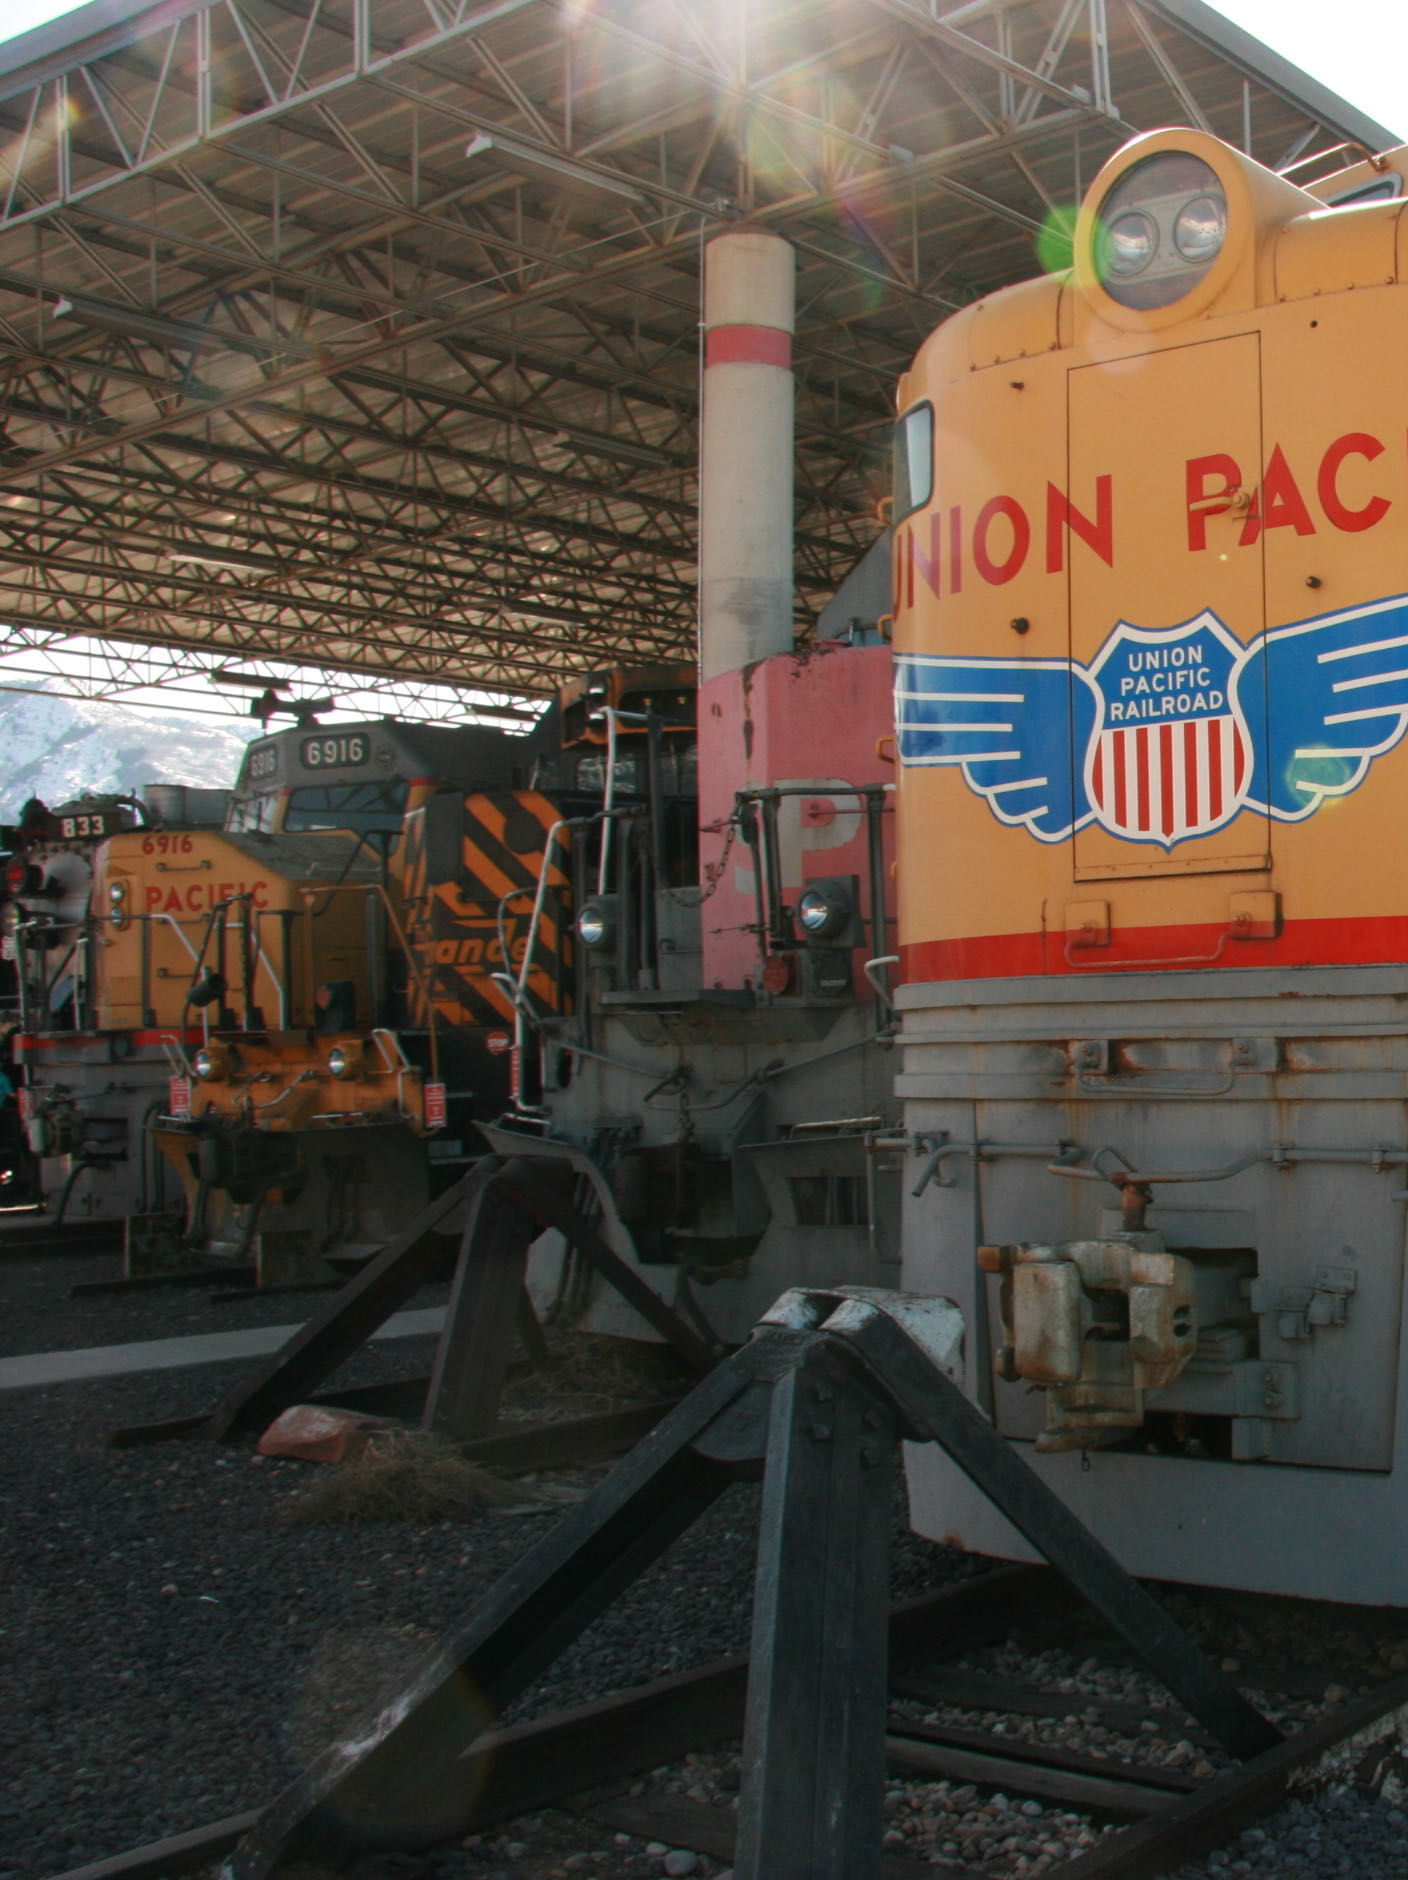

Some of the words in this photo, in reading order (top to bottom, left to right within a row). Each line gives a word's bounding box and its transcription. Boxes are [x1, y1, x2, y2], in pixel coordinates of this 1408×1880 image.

[1128, 645, 1202, 673] UNION
[1120, 667, 1210, 697] PACIFIC
[1110, 690, 1224, 721] RAILROAD
[307, 738, 362, 765] 6916
[62, 815, 104, 838] 833
[142, 834, 193, 856] 6916
[145, 881, 269, 912] PACIFIC
